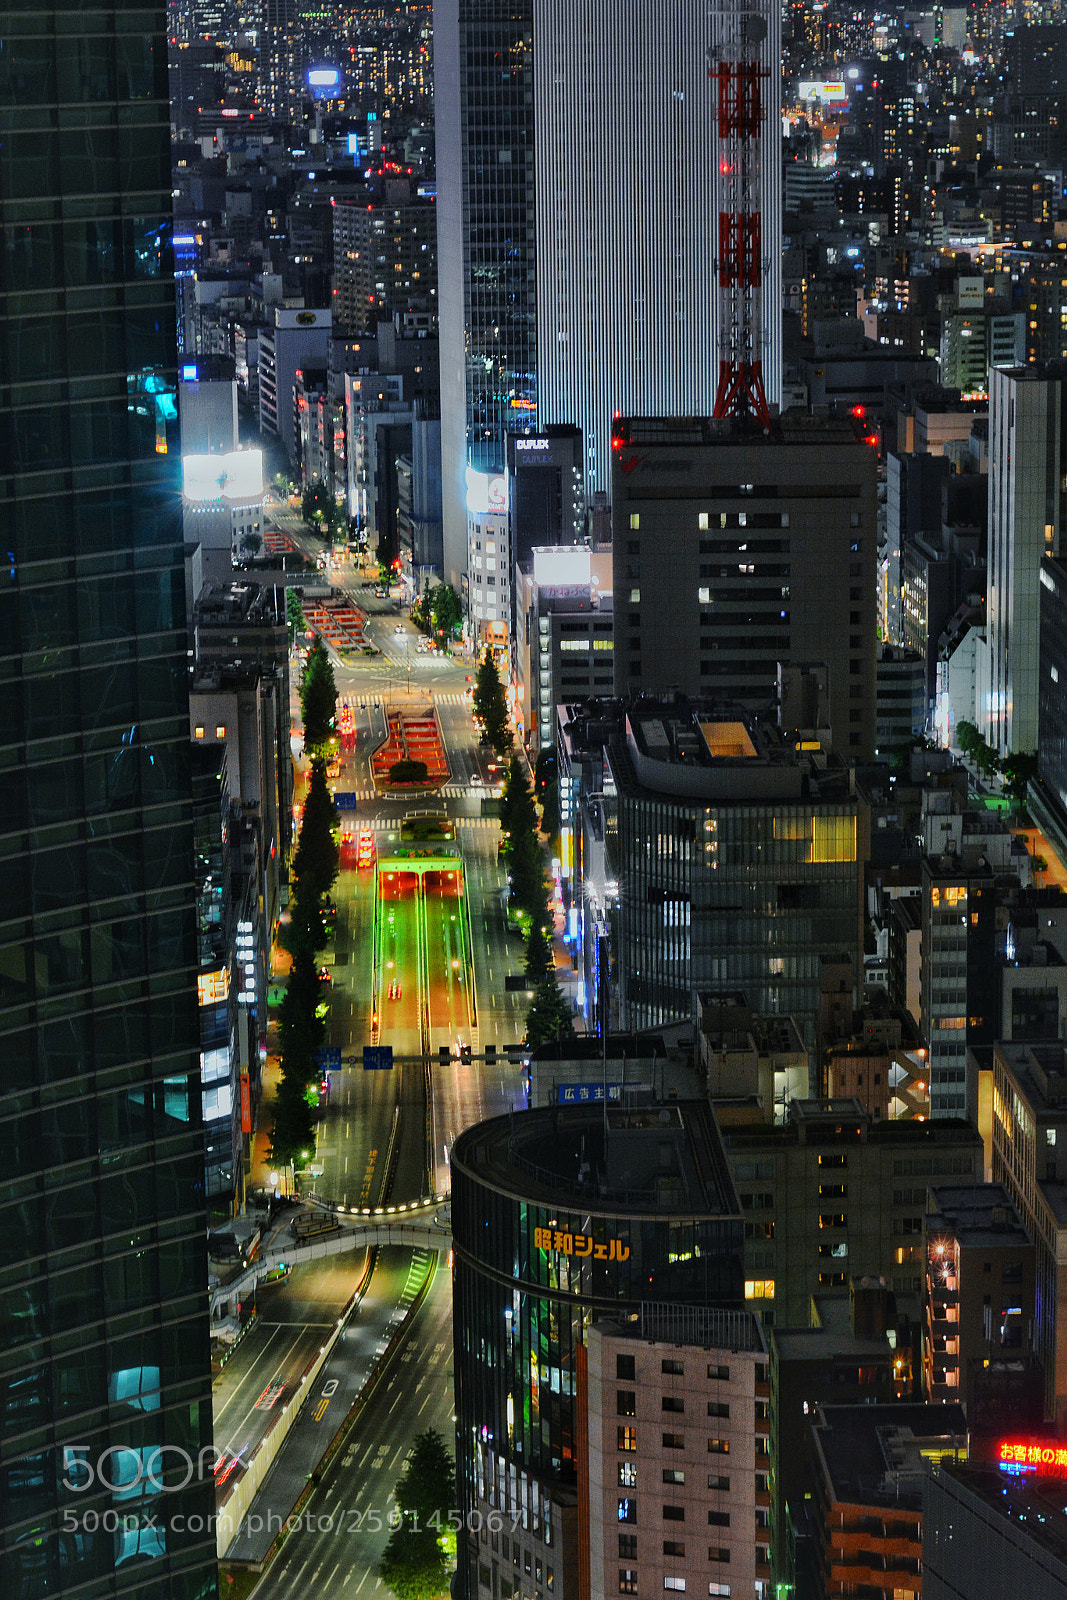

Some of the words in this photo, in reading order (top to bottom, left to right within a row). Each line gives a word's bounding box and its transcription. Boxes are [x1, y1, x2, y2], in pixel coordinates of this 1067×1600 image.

[534, 1227, 630, 1262] 昭和シェル
